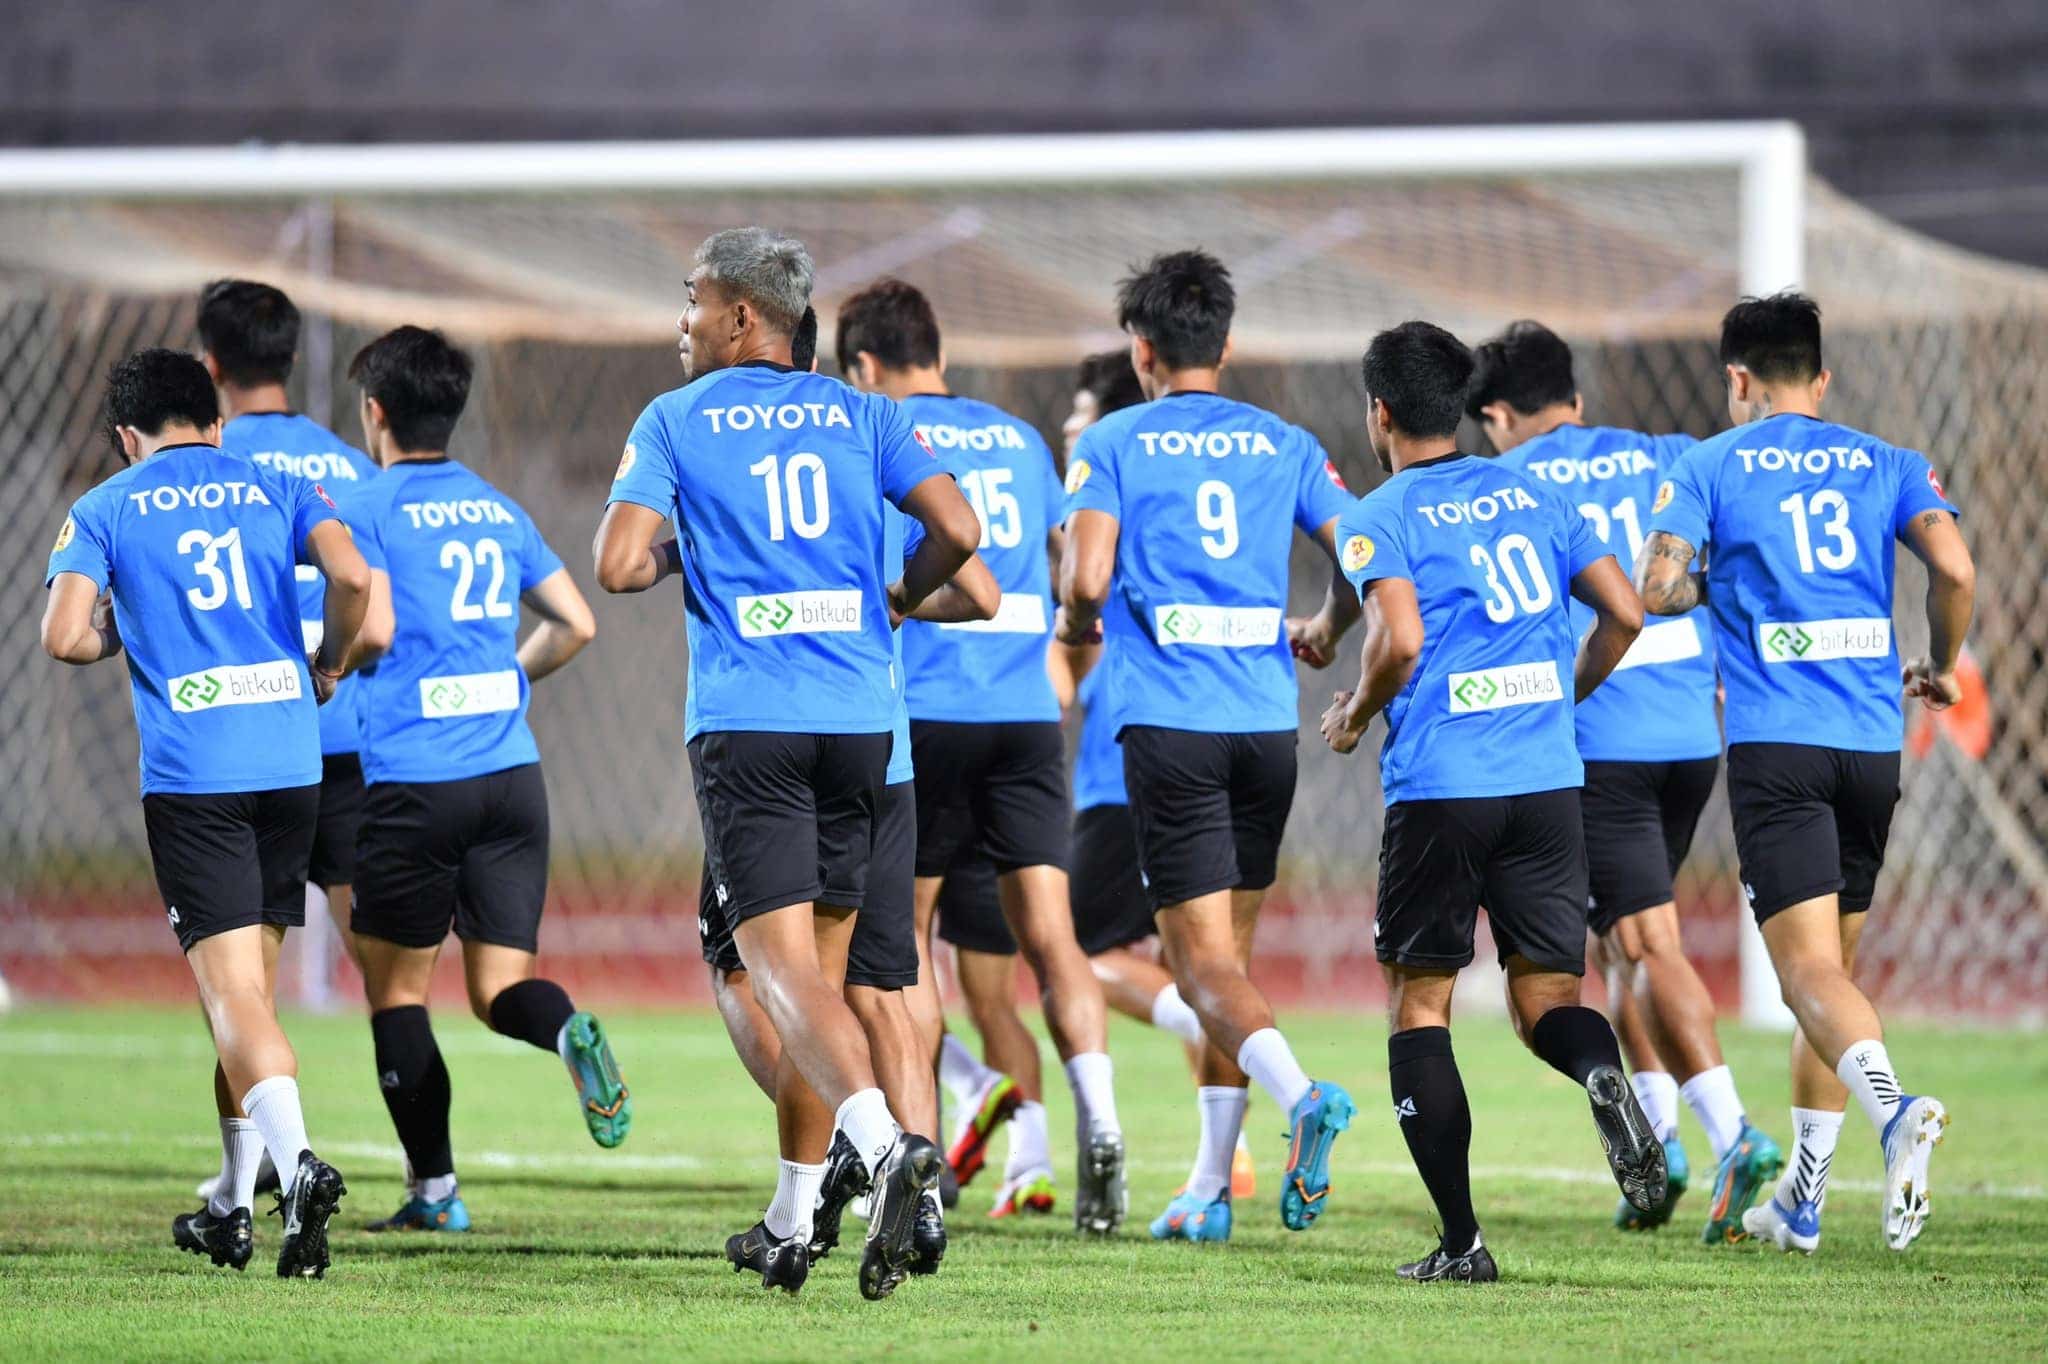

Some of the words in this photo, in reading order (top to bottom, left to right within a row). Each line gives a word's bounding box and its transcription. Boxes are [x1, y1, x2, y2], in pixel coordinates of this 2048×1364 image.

[703, 403, 851, 433] TOYOTA
[914, 425, 1026, 451] TOYOTA
[1137, 430, 1278, 458] TOYOTA
[1527, 449, 1656, 484] TOYOTA
[1735, 446, 1873, 474] TOYOTA
[129, 482, 270, 516] TOYOTA
[749, 452, 830, 541] 10
[961, 467, 1023, 549] 15
[1417, 487, 1539, 528] TOYOTA
[402, 499, 515, 529] TOYOTA
[1196, 479, 1239, 560] 9
[1779, 489, 1857, 574] 13
[177, 527, 253, 612] 31
[440, 537, 513, 622] 22
[1469, 533, 1553, 623] 30
[801, 599, 857, 624] bitkub
[1820, 626, 1884, 650] bitkub
[229, 668, 295, 696] bitkub
[1503, 670, 1554, 698] bitkb
